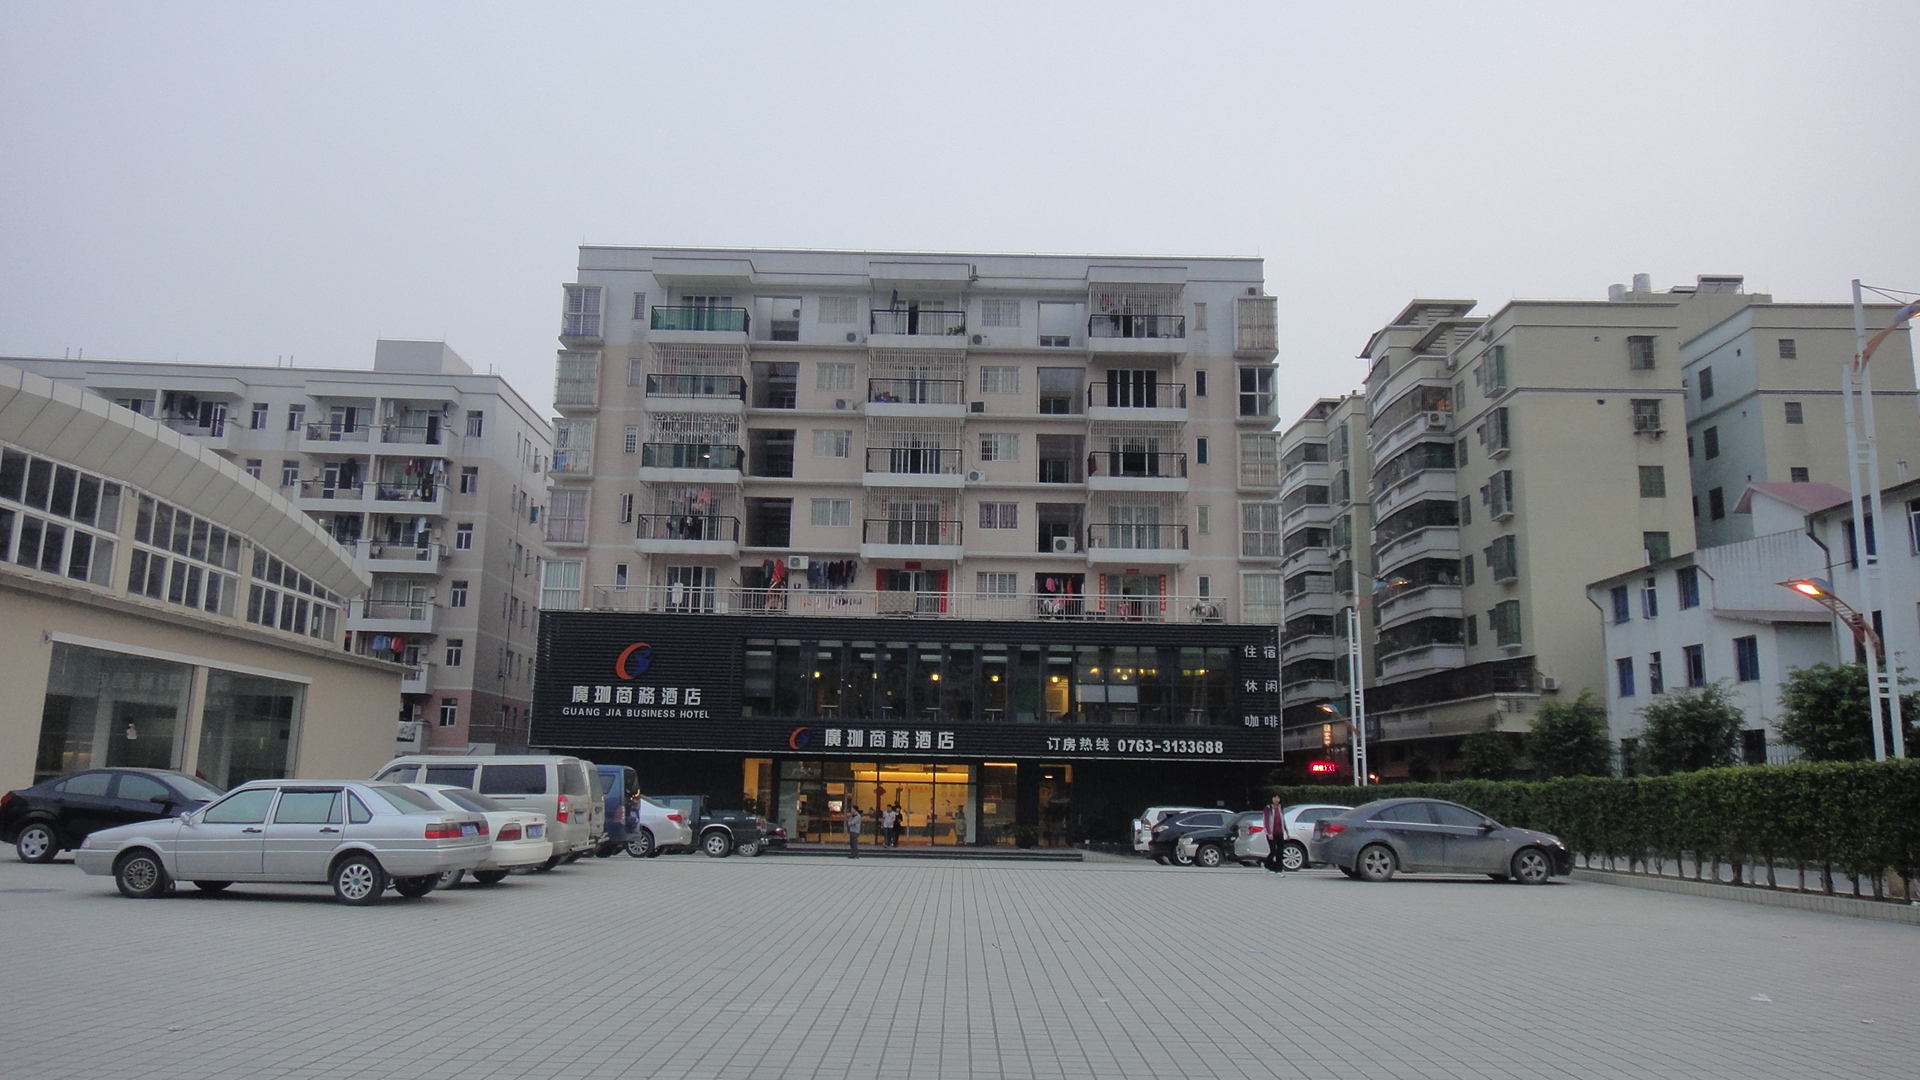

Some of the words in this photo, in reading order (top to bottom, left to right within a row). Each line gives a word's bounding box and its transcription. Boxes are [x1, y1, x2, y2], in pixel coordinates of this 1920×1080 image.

[1244, 645, 1277, 659] 住宿
[1245, 680, 1278, 693] 休闲
[572, 685, 702, 706] 廣珈商務酒店
[562, 707, 601, 717] GUANG
[605, 708, 622, 717] JIA
[626, 708, 676, 718] BUSINESS
[680, 710, 710, 719] HOTEL
[1244, 714, 1279, 728] 咖啡
[824, 728, 955, 750] 廣珈商務酒店
[1047, 736, 1110, 751] 订房热线
[1117, 739, 1224, 754] 0763-3133688
